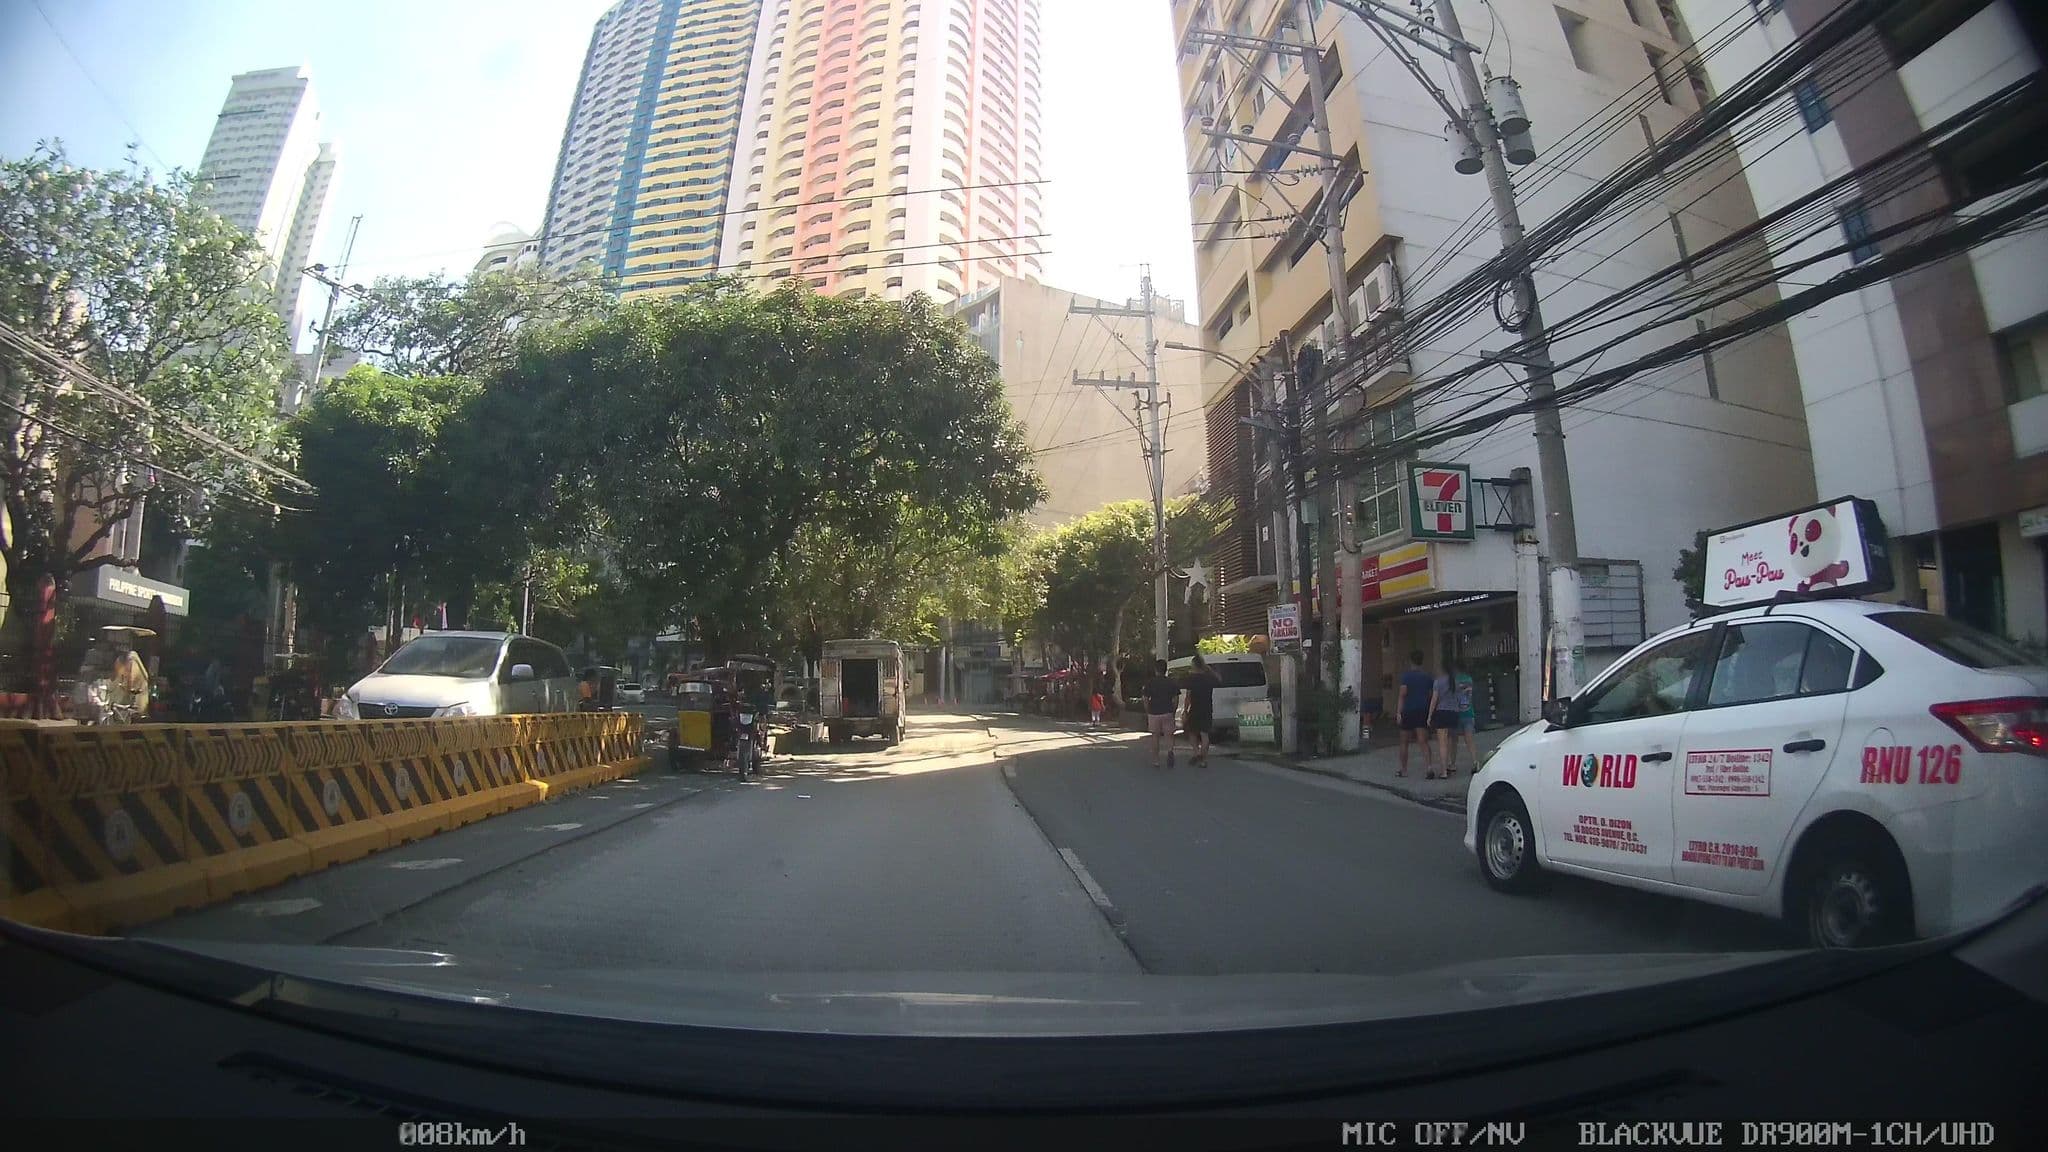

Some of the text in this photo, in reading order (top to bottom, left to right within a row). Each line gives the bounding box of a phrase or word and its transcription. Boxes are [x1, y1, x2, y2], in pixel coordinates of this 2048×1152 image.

[1423, 472, 1460, 532] 7
[1724, 561, 1784, 590] Pau-Pau
[1271, 627, 1297, 638] PARKING
[1272, 618, 1294, 628] NO
[1562, 754, 1638, 789] WORLD
[1859, 744, 1962, 784] RNU 126
